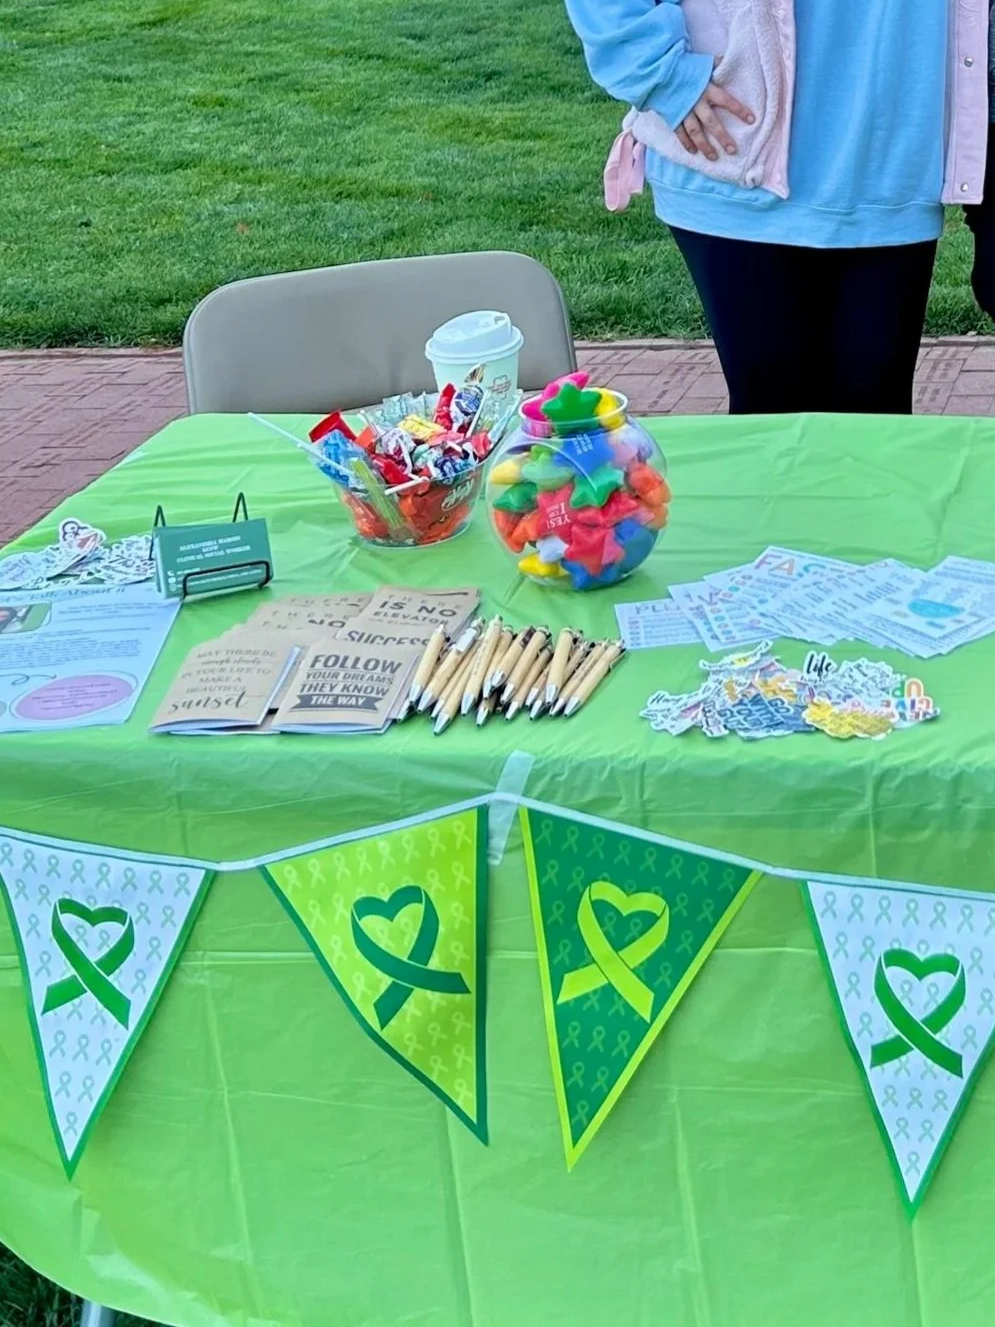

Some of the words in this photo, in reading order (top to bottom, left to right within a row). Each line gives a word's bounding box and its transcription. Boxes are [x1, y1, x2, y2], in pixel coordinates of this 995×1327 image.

[379, 601, 407, 610] IS
[418, 605, 457, 617] NO
[373, 610, 449, 625] ELEVATOR
[310, 654, 402, 674] FOLLOW
[306, 672, 341, 680] YOUR
[342, 672, 395, 685] DREAMS
[300, 682, 338, 693] THEY
[340, 683, 390, 696] KNOW
[310, 695, 336, 705] THE
[337, 696, 367, 706] WAY
